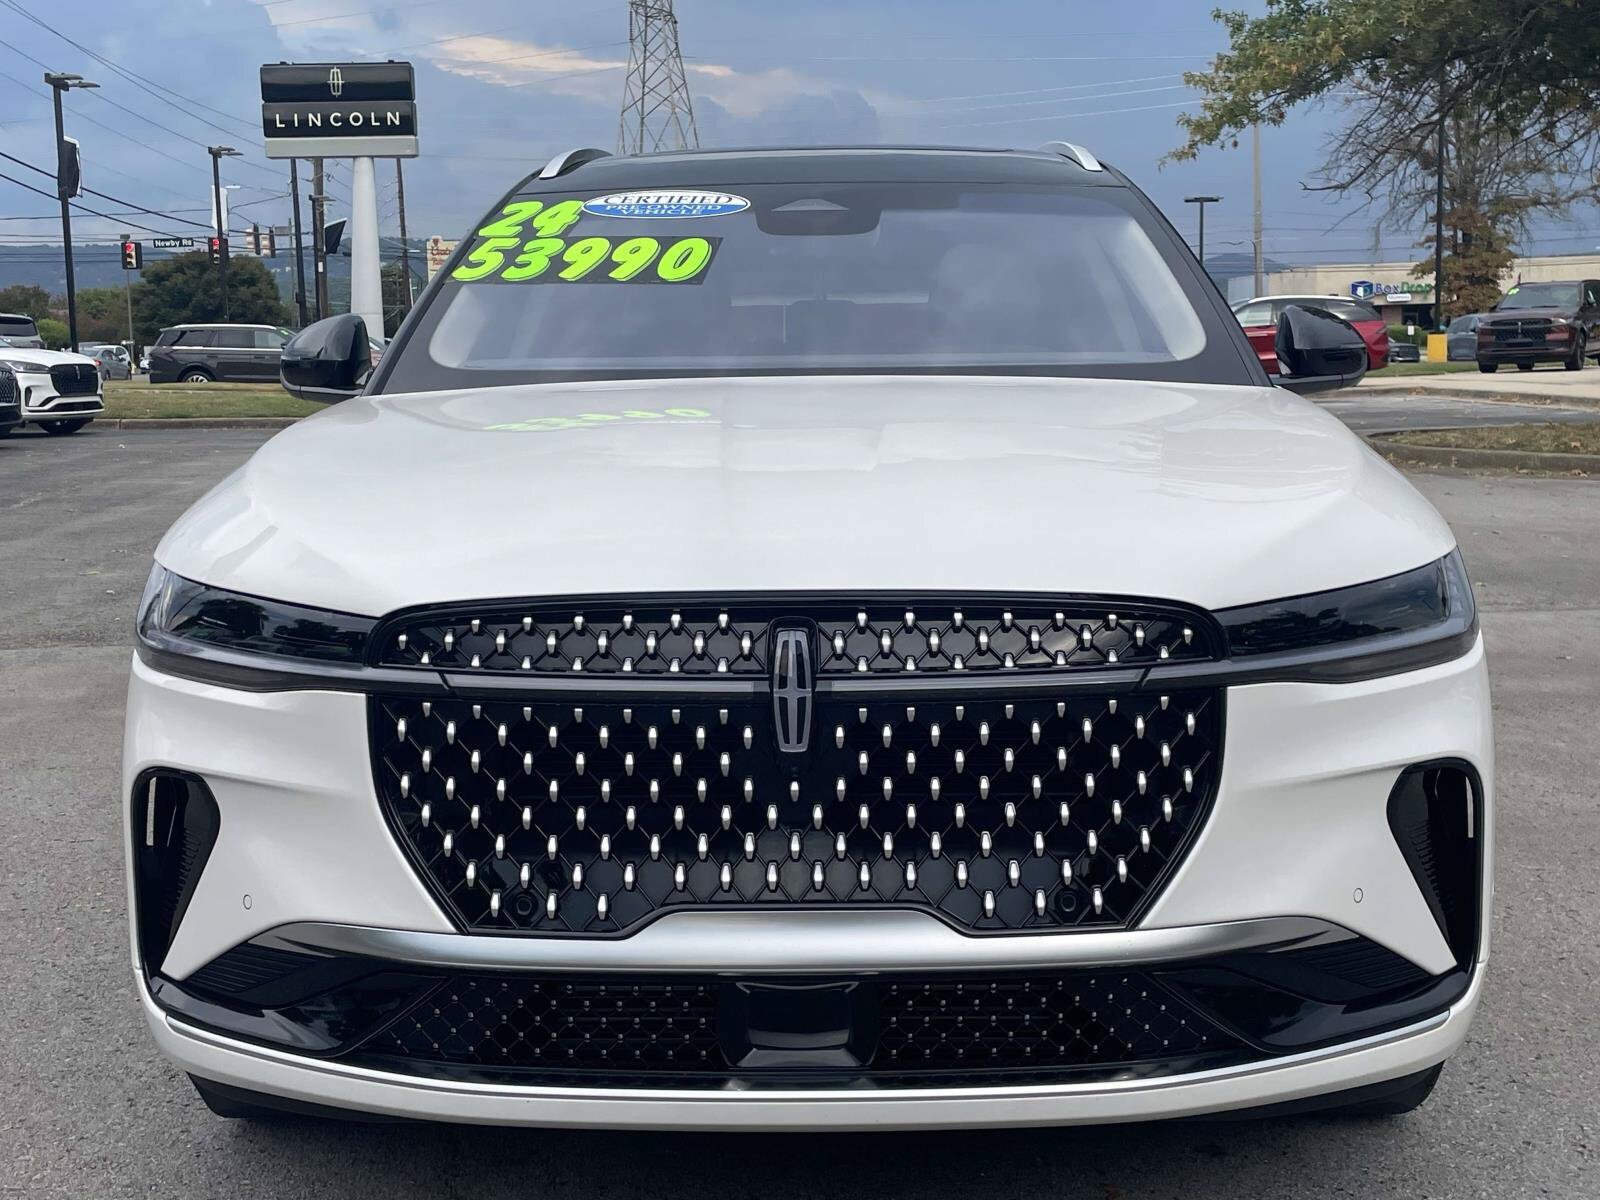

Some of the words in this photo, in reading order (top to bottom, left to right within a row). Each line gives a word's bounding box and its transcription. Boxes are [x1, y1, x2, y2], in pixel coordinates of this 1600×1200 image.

[275, 111, 400, 128] LINCOLN
[603, 194, 733, 205] CERTIFIED
[478, 200, 584, 238] 24
[451, 237, 713, 282] 53990
